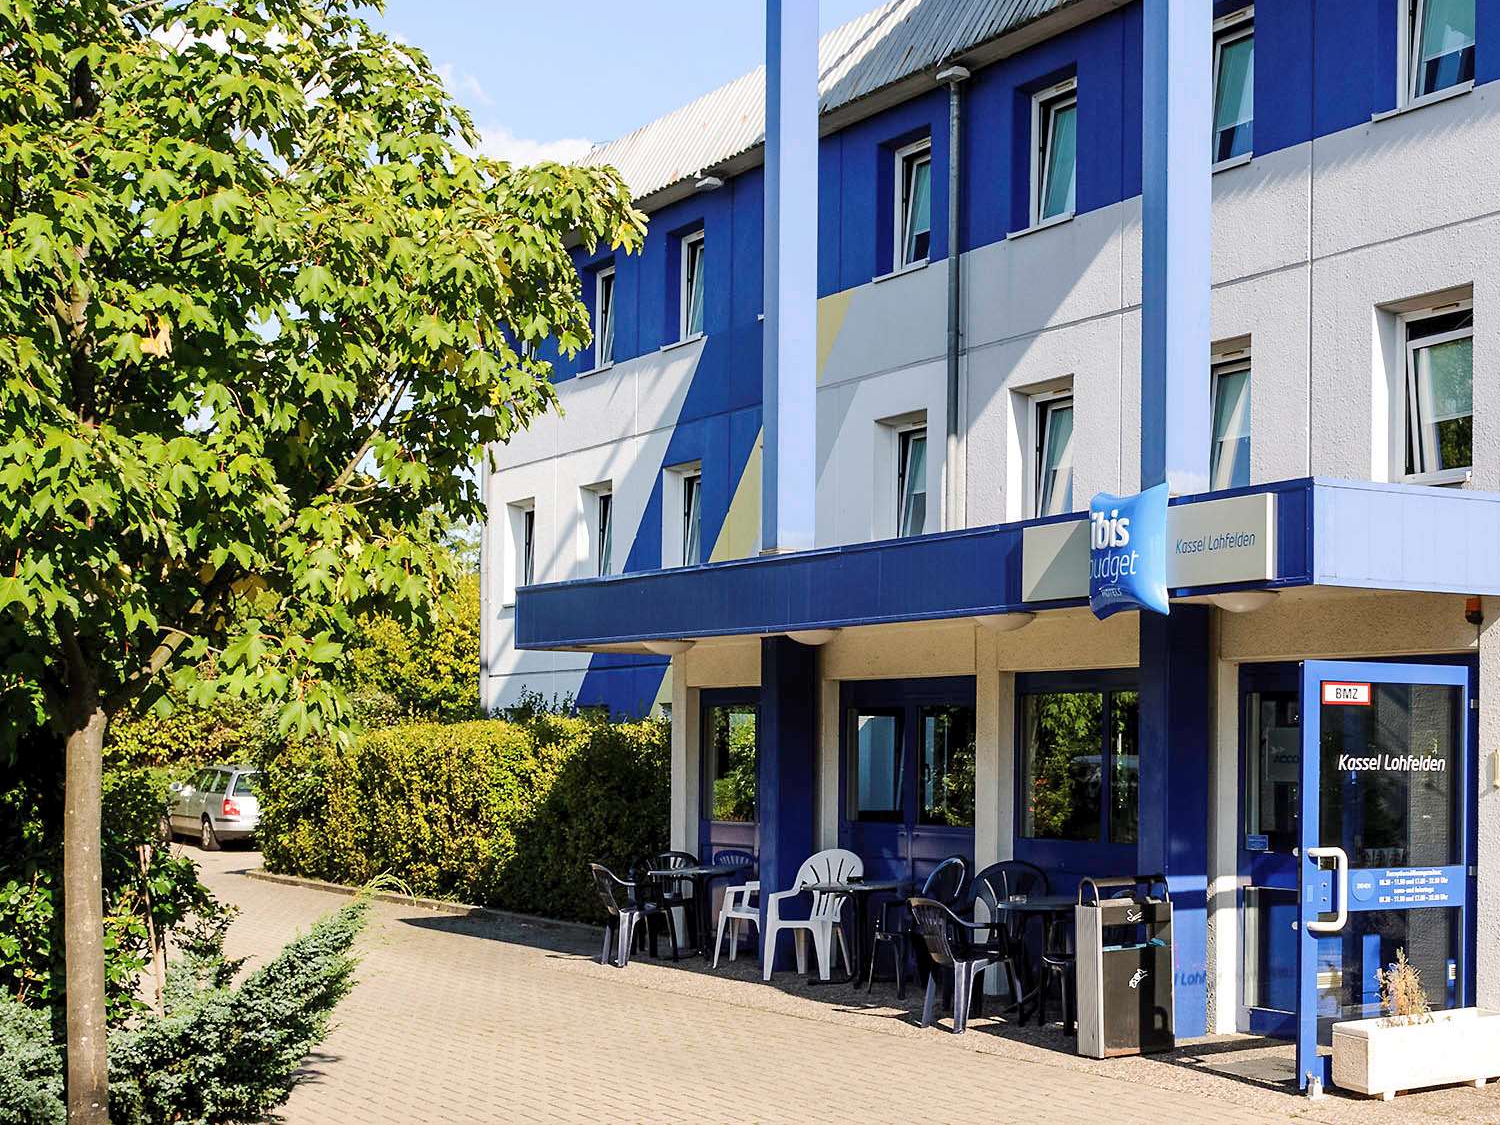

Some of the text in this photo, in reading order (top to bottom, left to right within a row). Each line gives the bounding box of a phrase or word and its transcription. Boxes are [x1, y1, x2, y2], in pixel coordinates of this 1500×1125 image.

[1091, 509, 1130, 550] ibis
[1175, 531, 1256, 554] Kassel Lohfelden
[1335, 687, 1358, 700] BMZ
[1338, 754, 1446, 772] Kassel Lohfelden
